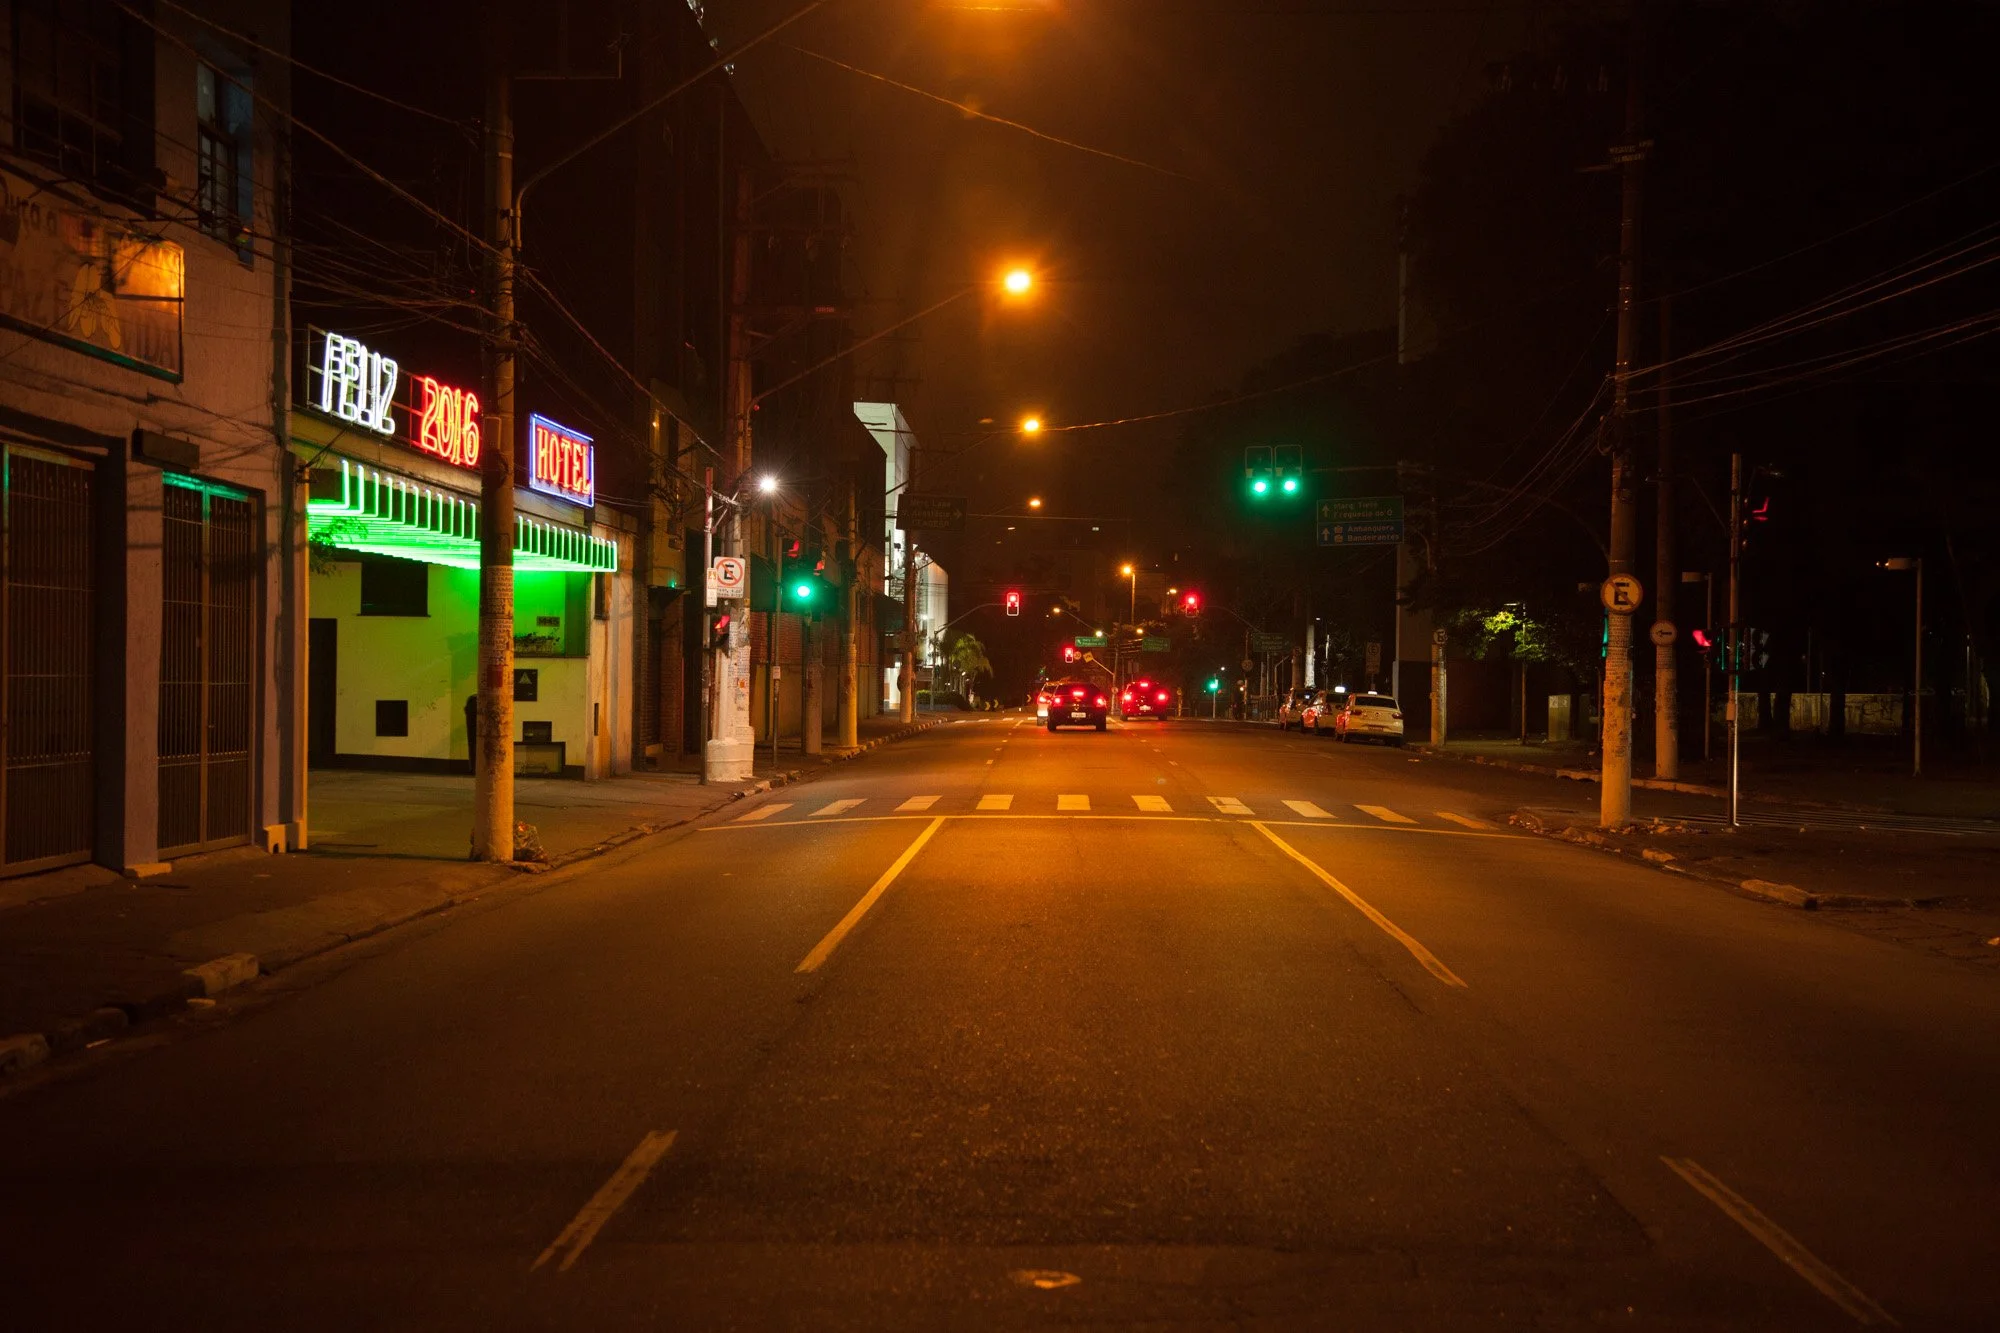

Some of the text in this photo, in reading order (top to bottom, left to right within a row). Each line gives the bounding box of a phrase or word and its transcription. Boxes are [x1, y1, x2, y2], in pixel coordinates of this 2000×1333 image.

[322, 332, 480, 466] FELIZ 2016
[535, 426, 592, 496] HOTEL
[1614, 582, 1629, 605] E
